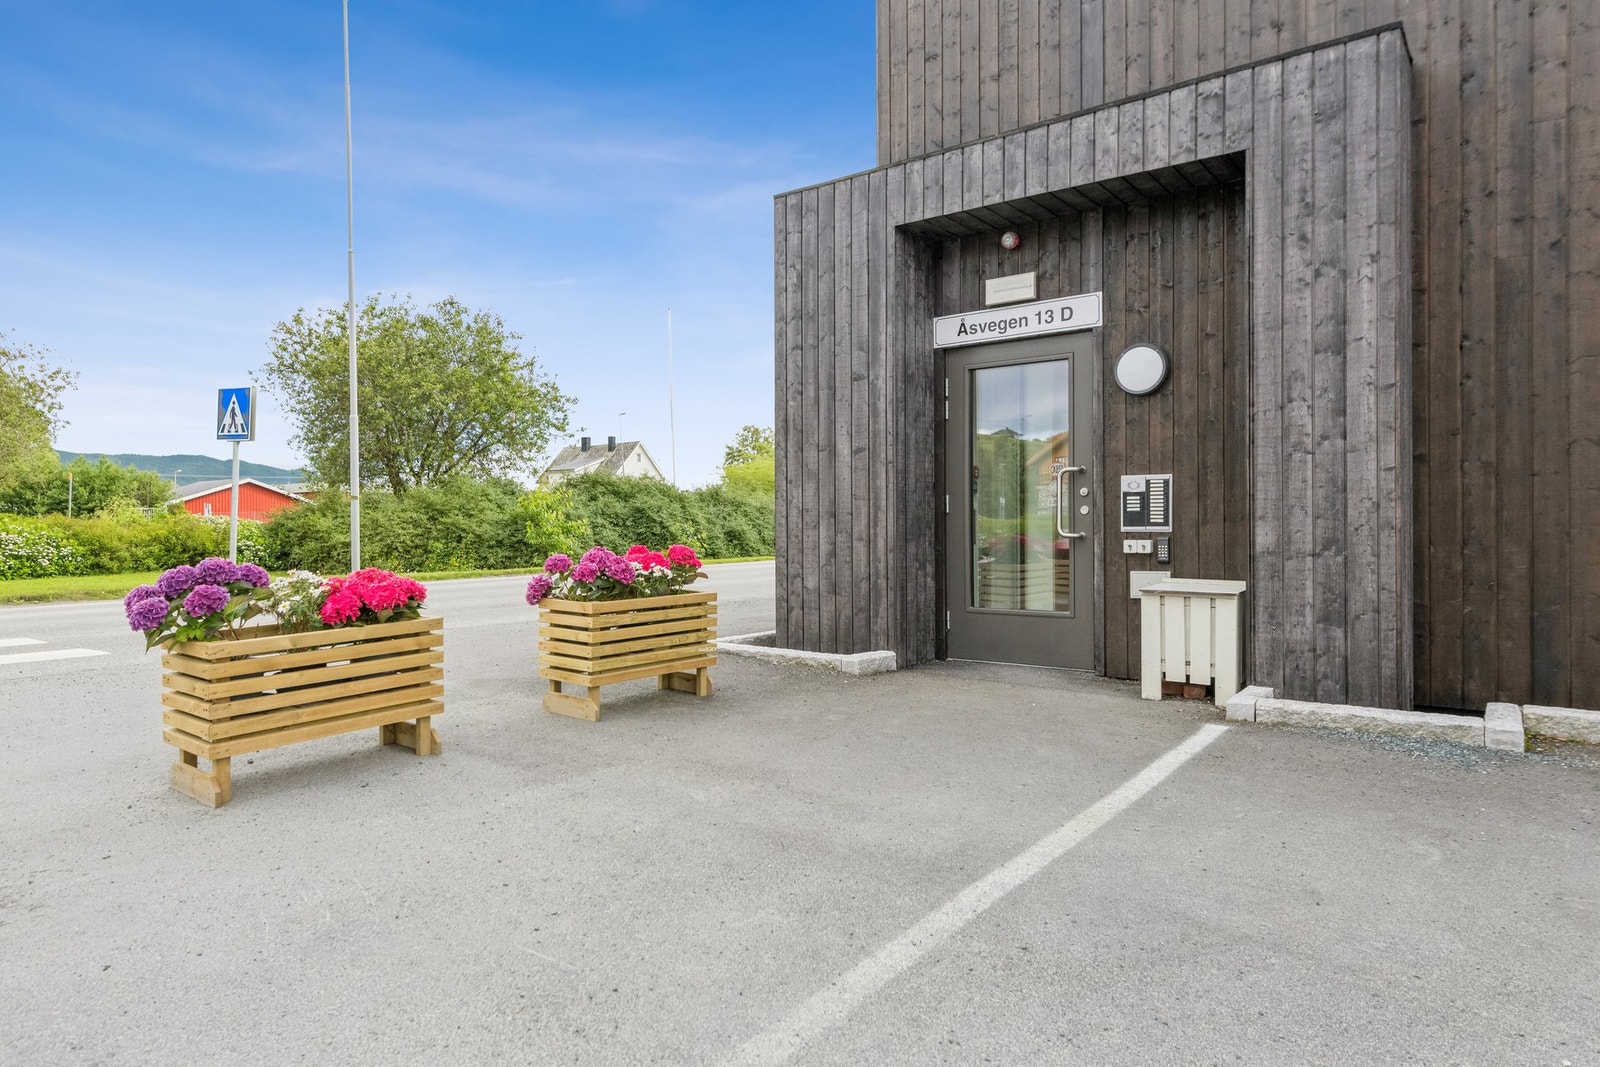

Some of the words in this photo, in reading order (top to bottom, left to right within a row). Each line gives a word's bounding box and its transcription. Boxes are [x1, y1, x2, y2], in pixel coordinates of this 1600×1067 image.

[957, 316, 1029, 337] Åsvegen
[1035, 309, 1055, 325] 13
[1061, 306, 1074, 322] D
